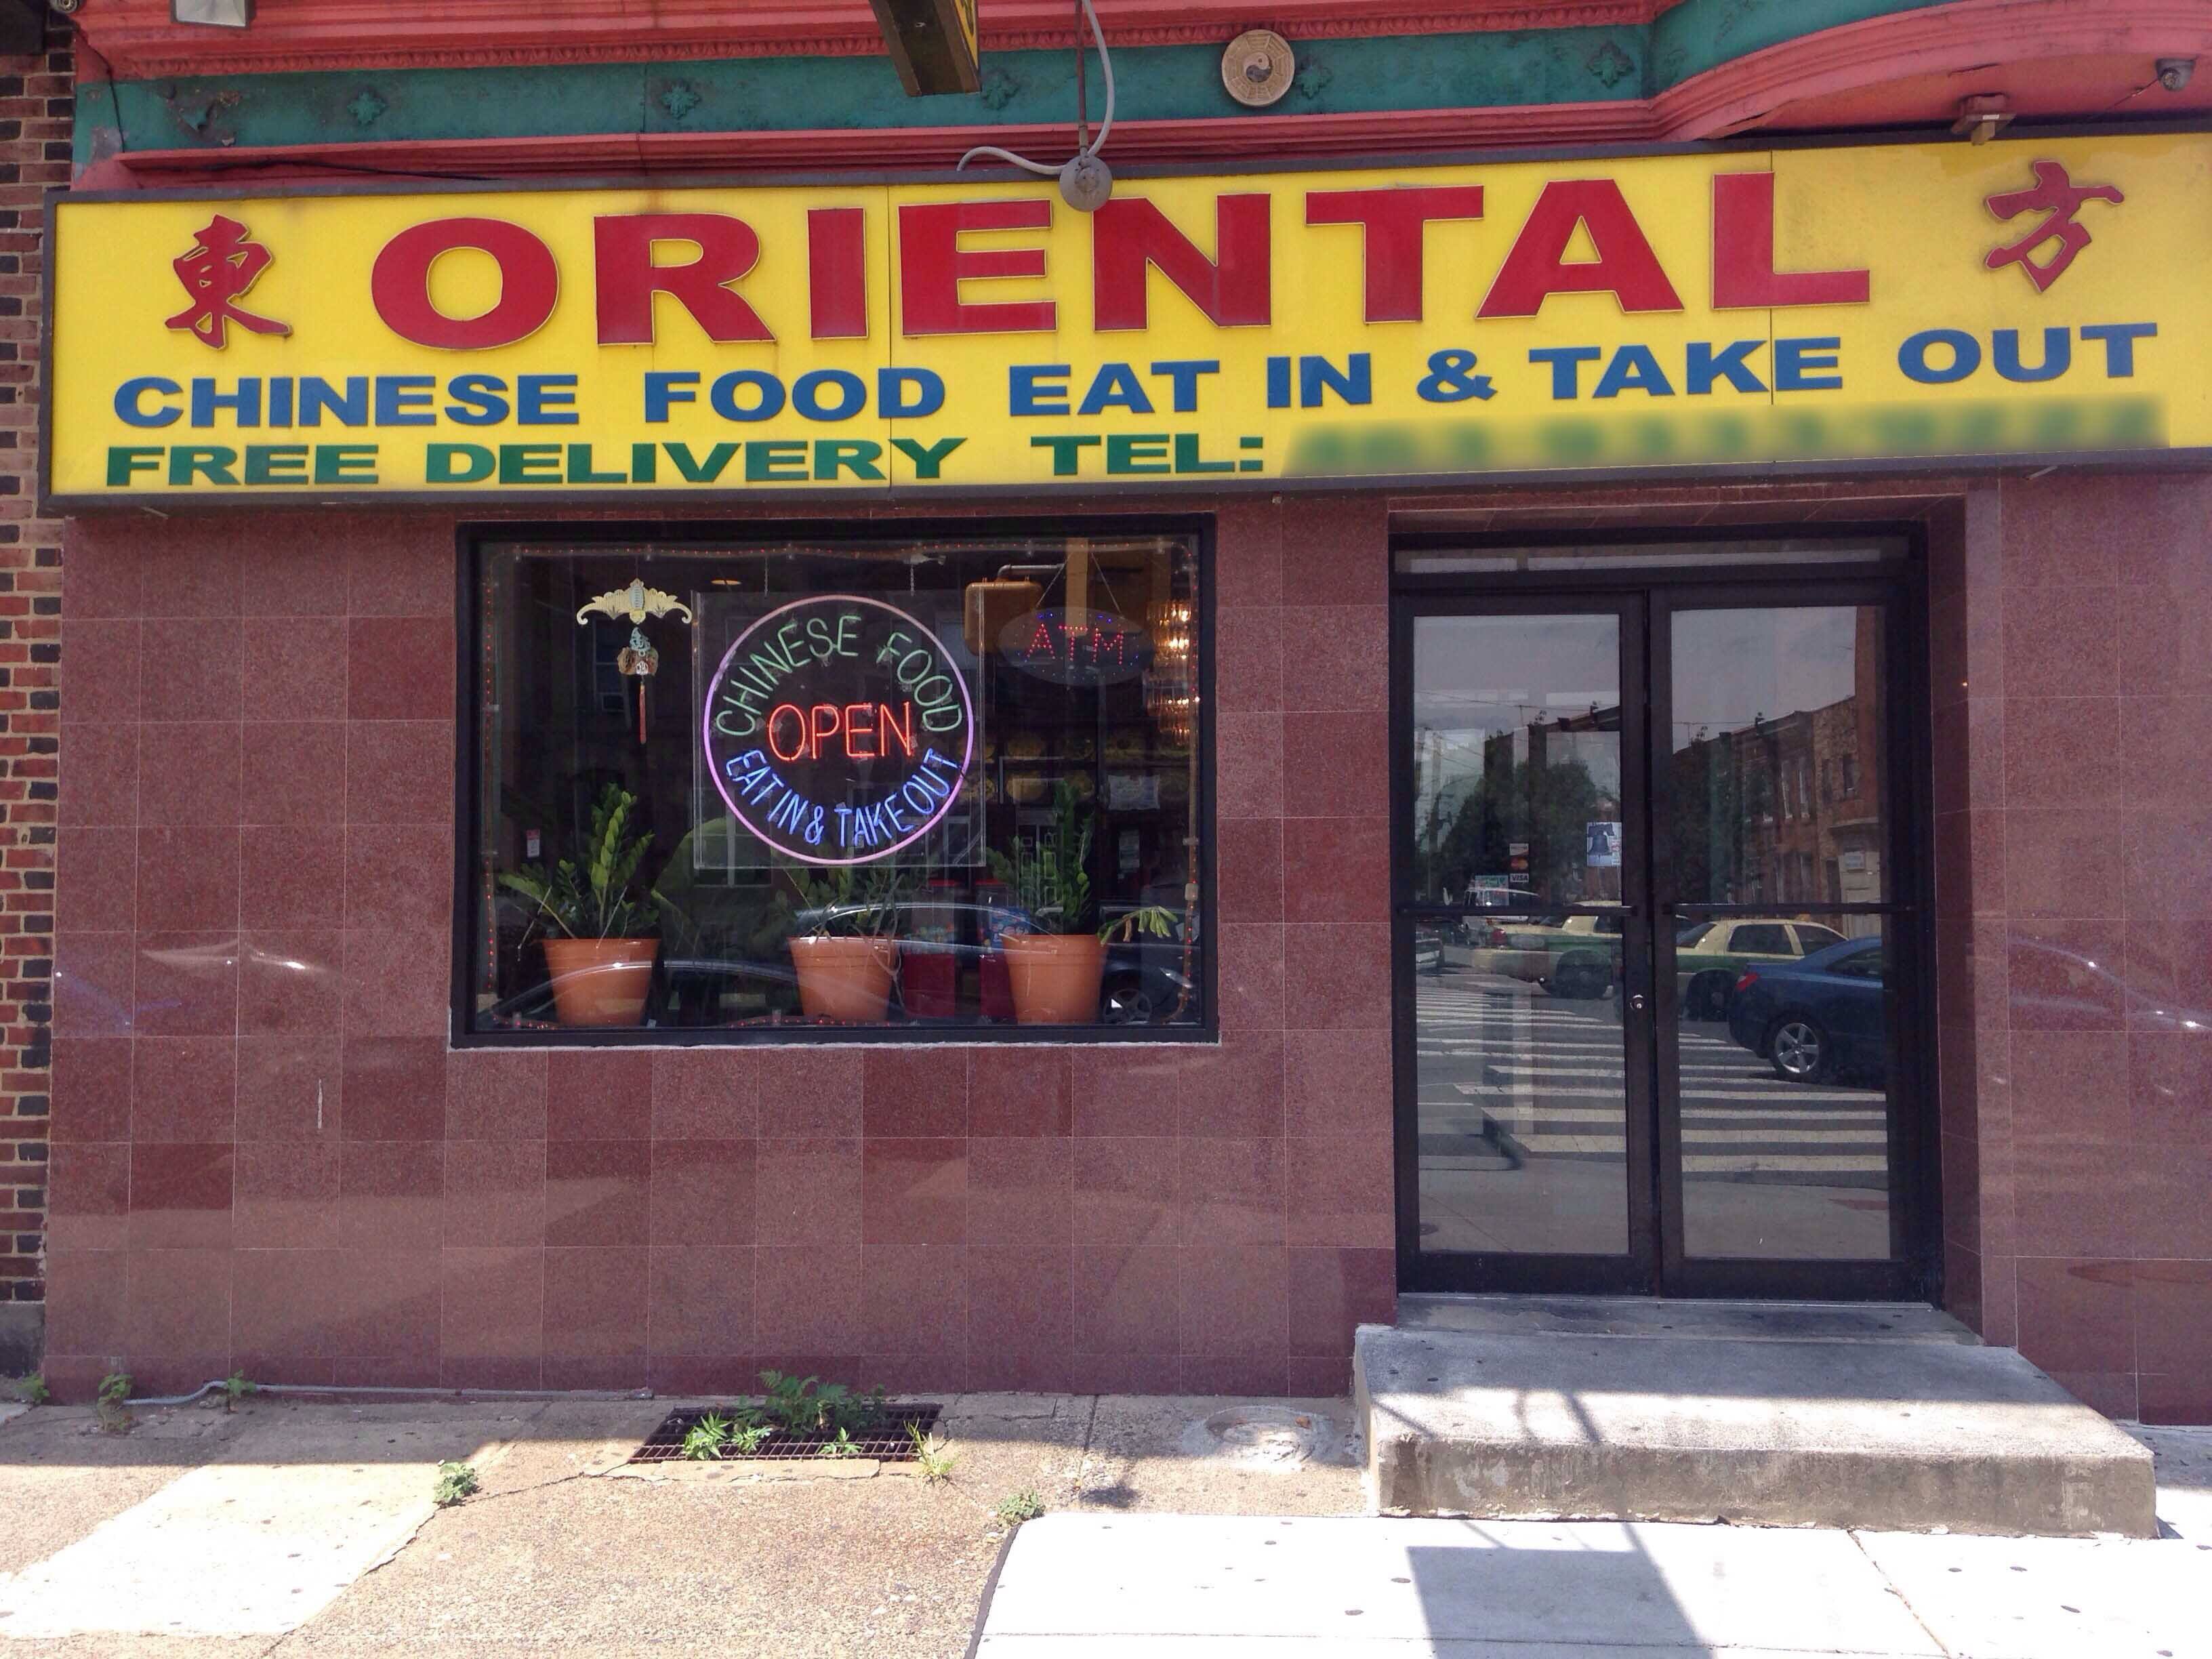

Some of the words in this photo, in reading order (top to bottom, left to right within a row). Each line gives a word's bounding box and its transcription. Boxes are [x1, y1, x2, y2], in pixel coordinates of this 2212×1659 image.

[371, 171, 1870, 351] ORIENTAL
[1984, 159, 2125, 294] 方
[165, 213, 293, 350] 東
[114, 374, 579, 428] CHINESE
[644, 367, 945, 424] FOOD
[1009, 359, 1220, 417] EAT
[1266, 352, 1372, 409] IN
[1416, 348, 1498, 404] &
[1528, 336, 1843, 401] TAKE
[1897, 322, 2158, 384] OUT
[106, 443, 380, 487] FREE
[425, 436, 968, 486] DELIVERY
[1029, 432, 1264, 477] TEL:
[715, 615, 862, 737] CHINESE
[876, 632, 962, 732] FOOD
[1026, 622, 1124, 665] ATM
[768, 701, 912, 762] OPEN
[725, 748, 785, 806] EAT
[768, 789, 809, 836] IN
[804, 804, 825, 846] &
